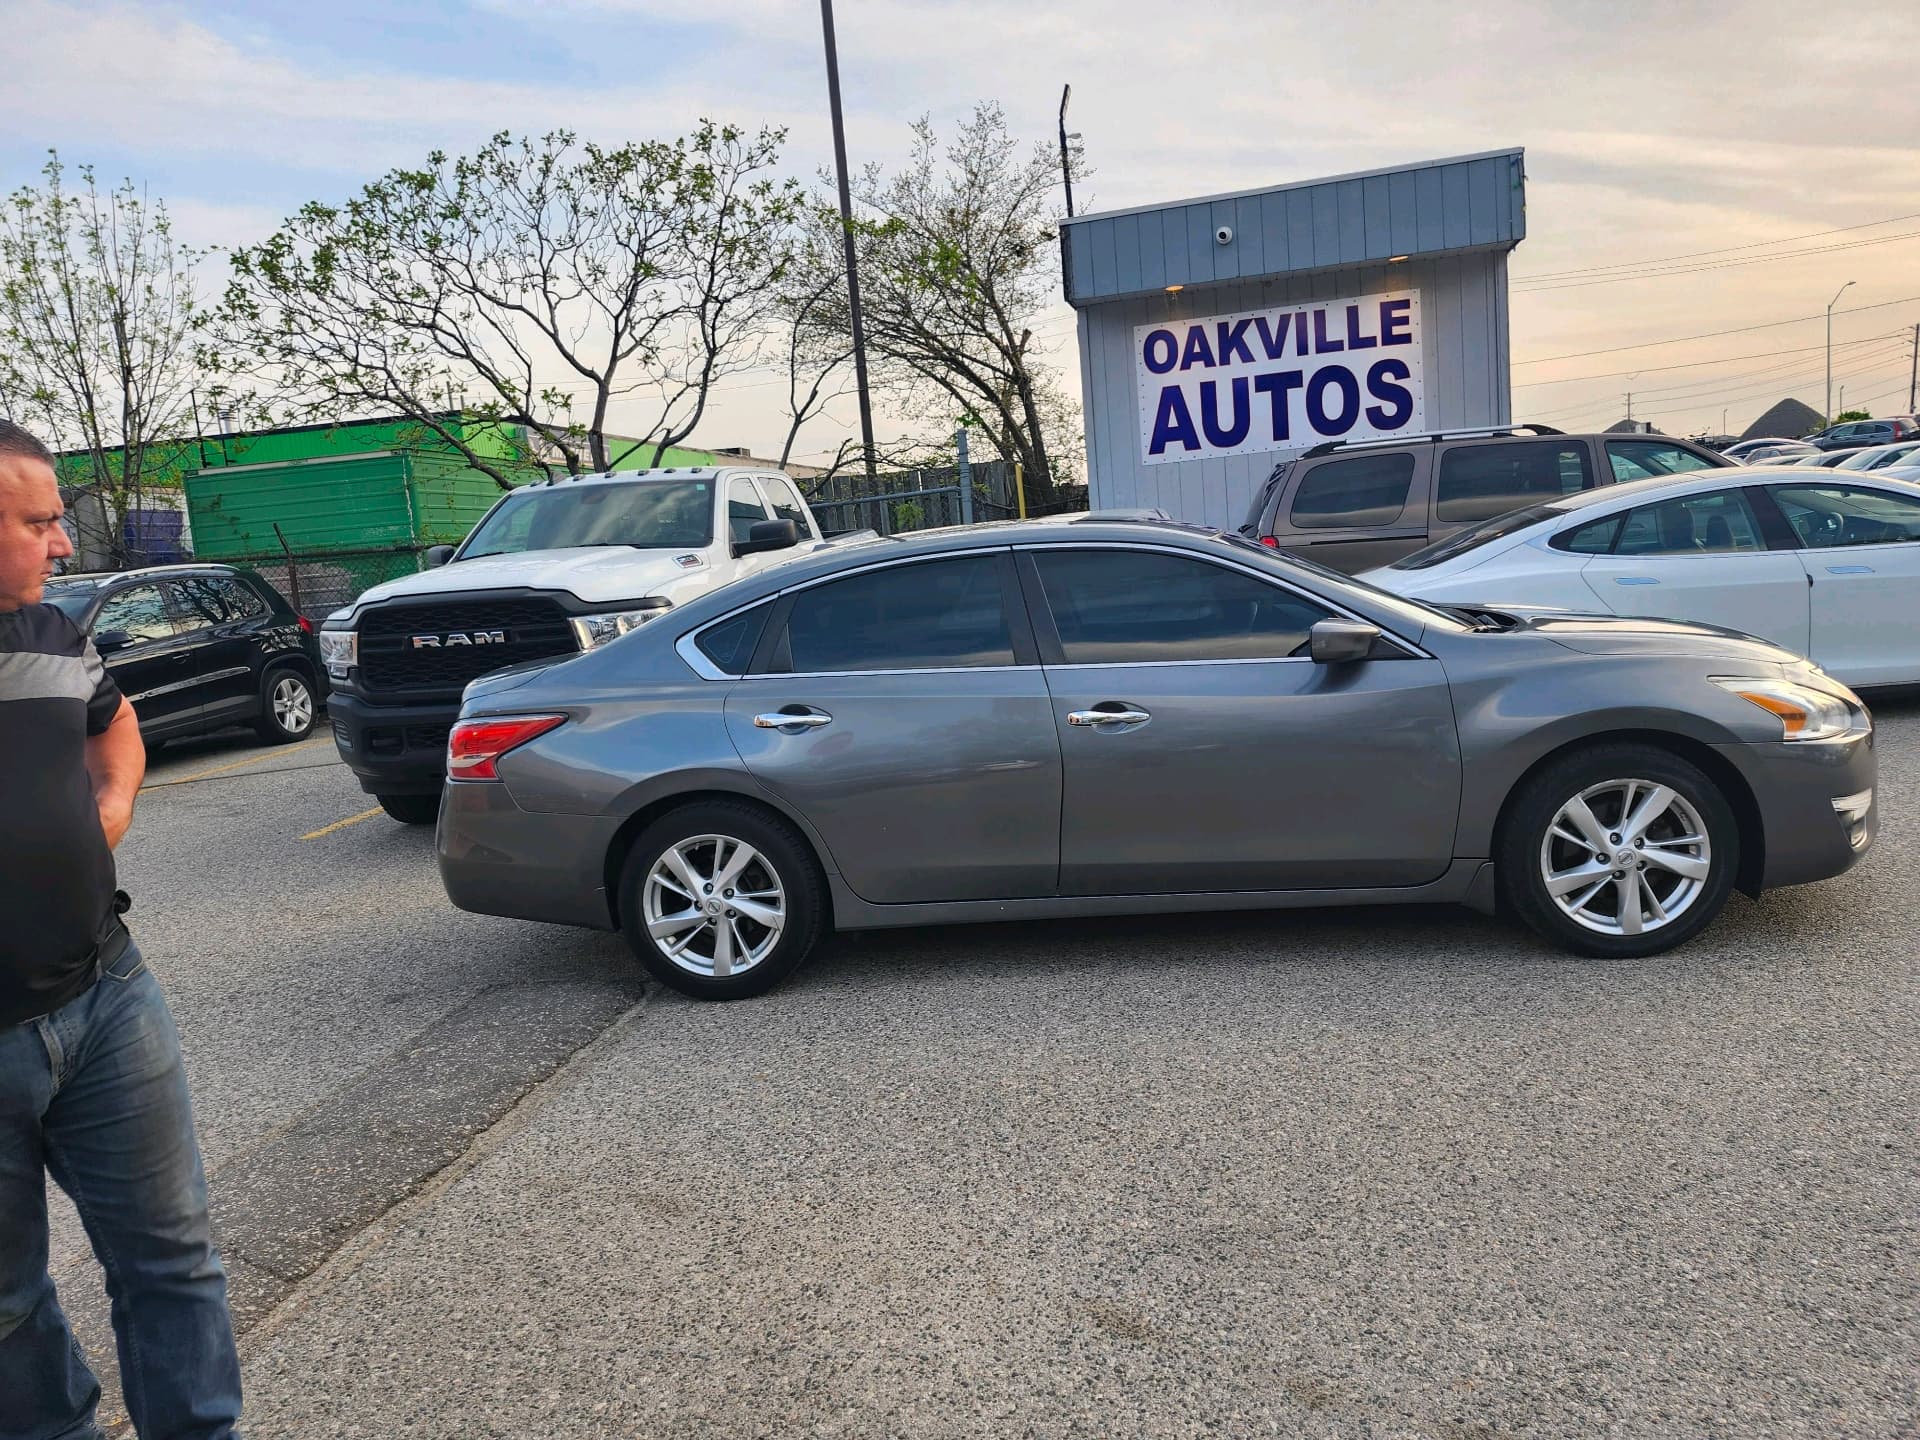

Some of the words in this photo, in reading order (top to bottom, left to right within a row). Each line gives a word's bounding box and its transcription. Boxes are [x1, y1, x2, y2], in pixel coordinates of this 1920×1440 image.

[1144, 299, 1412, 374] OAKVILLE
[1149, 358, 1413, 455] AUTOS
[412, 631, 505, 649] RAM
